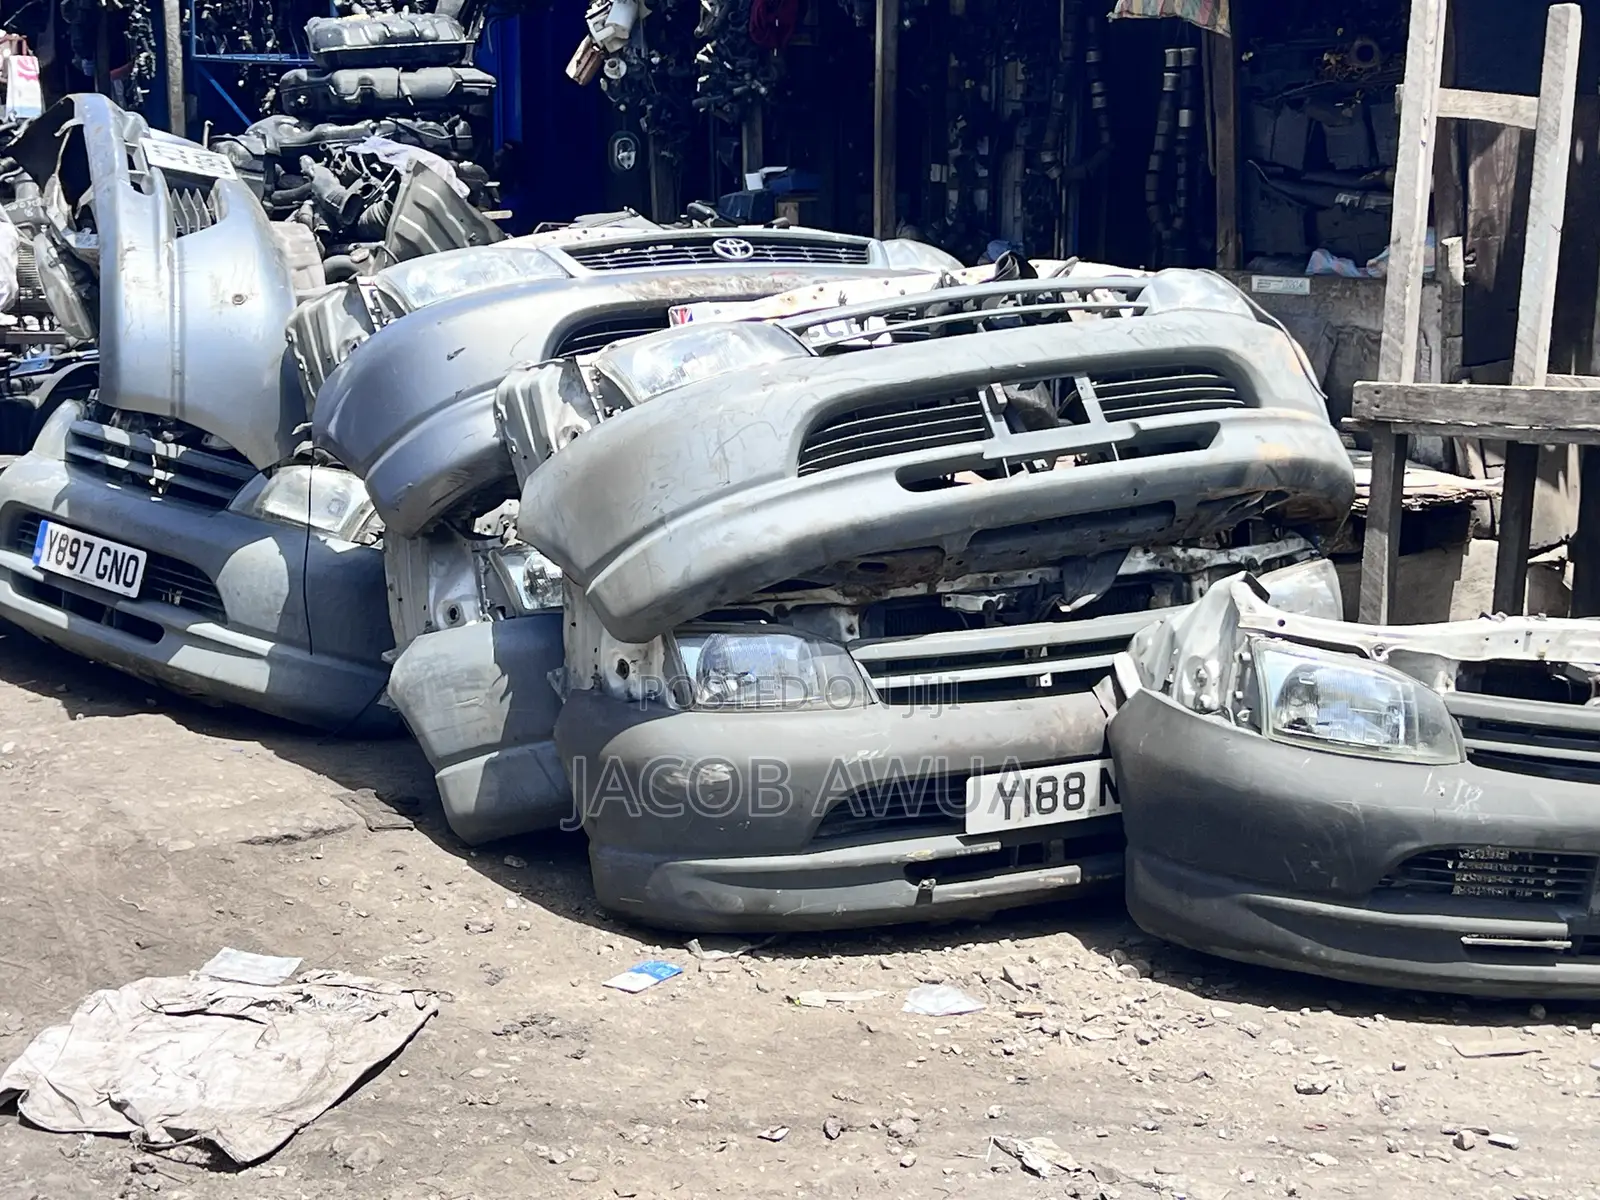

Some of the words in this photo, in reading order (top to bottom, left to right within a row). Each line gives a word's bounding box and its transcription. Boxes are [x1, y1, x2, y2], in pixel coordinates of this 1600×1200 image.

[47, 529, 95, 575] Y897
[95, 546, 140, 589] GNO
[996, 771, 1086, 821] Y188
